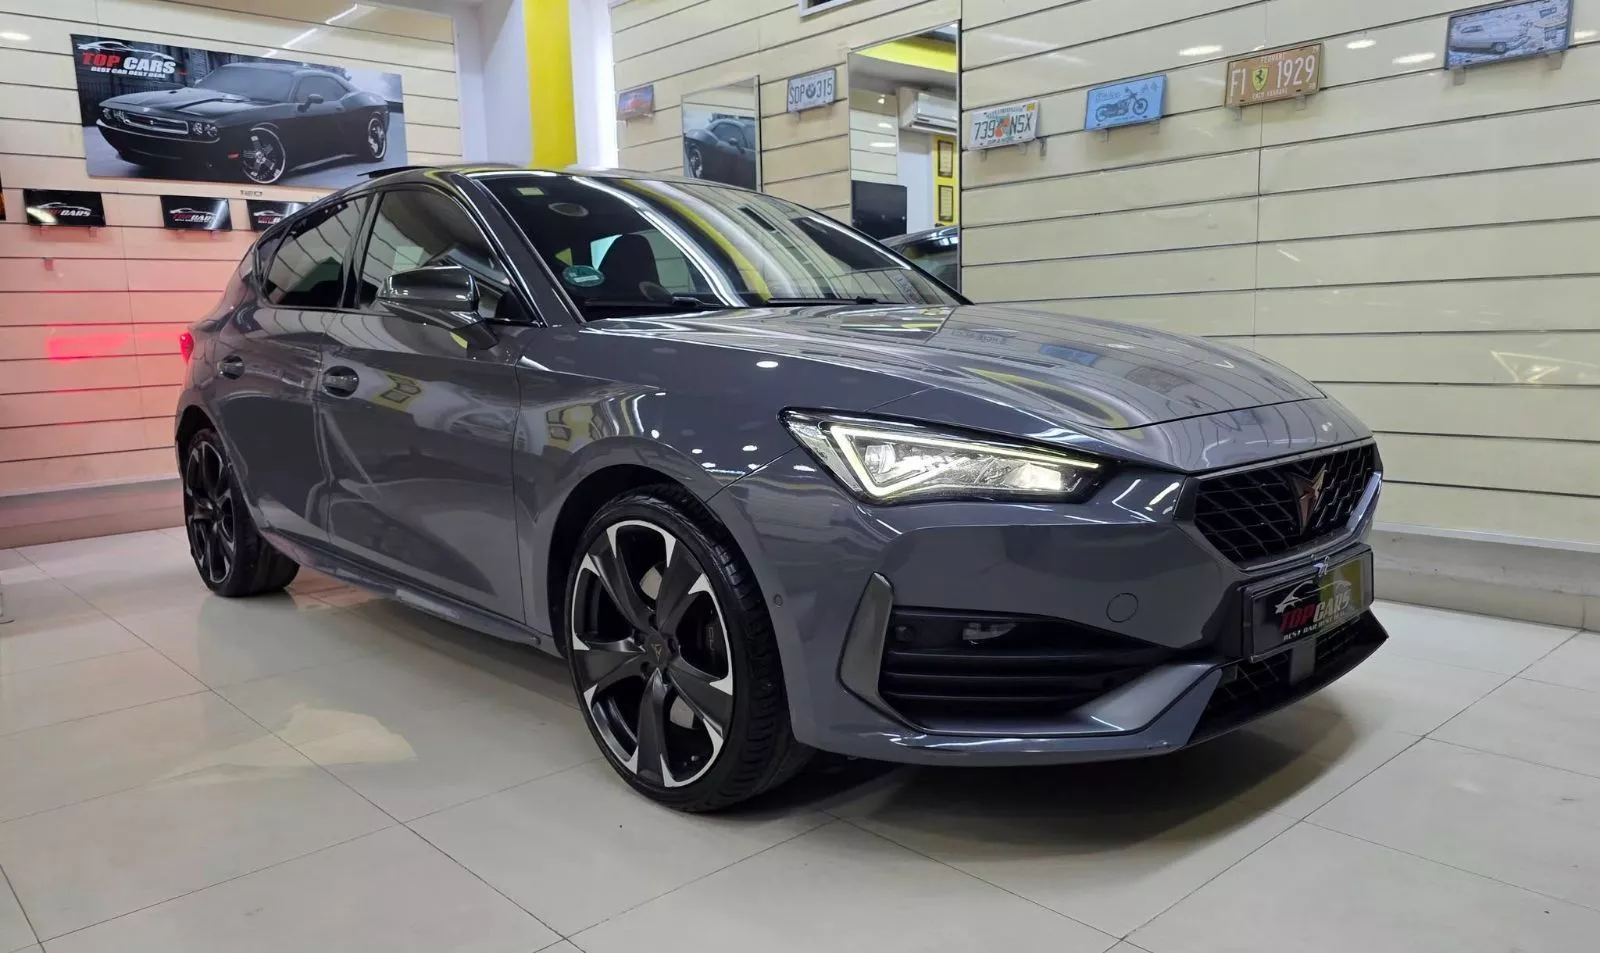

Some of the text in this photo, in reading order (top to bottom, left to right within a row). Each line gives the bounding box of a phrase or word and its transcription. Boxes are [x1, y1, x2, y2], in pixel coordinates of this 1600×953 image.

[83, 52, 176, 74] TOP CARS
[1230, 55, 1316, 97] F1 1929
[816, 77, 833, 98] 315
[974, 120, 996, 141] 739
[1010, 112, 1033, 137] NSX
[1280, 590, 1350, 632] TOP CARS
